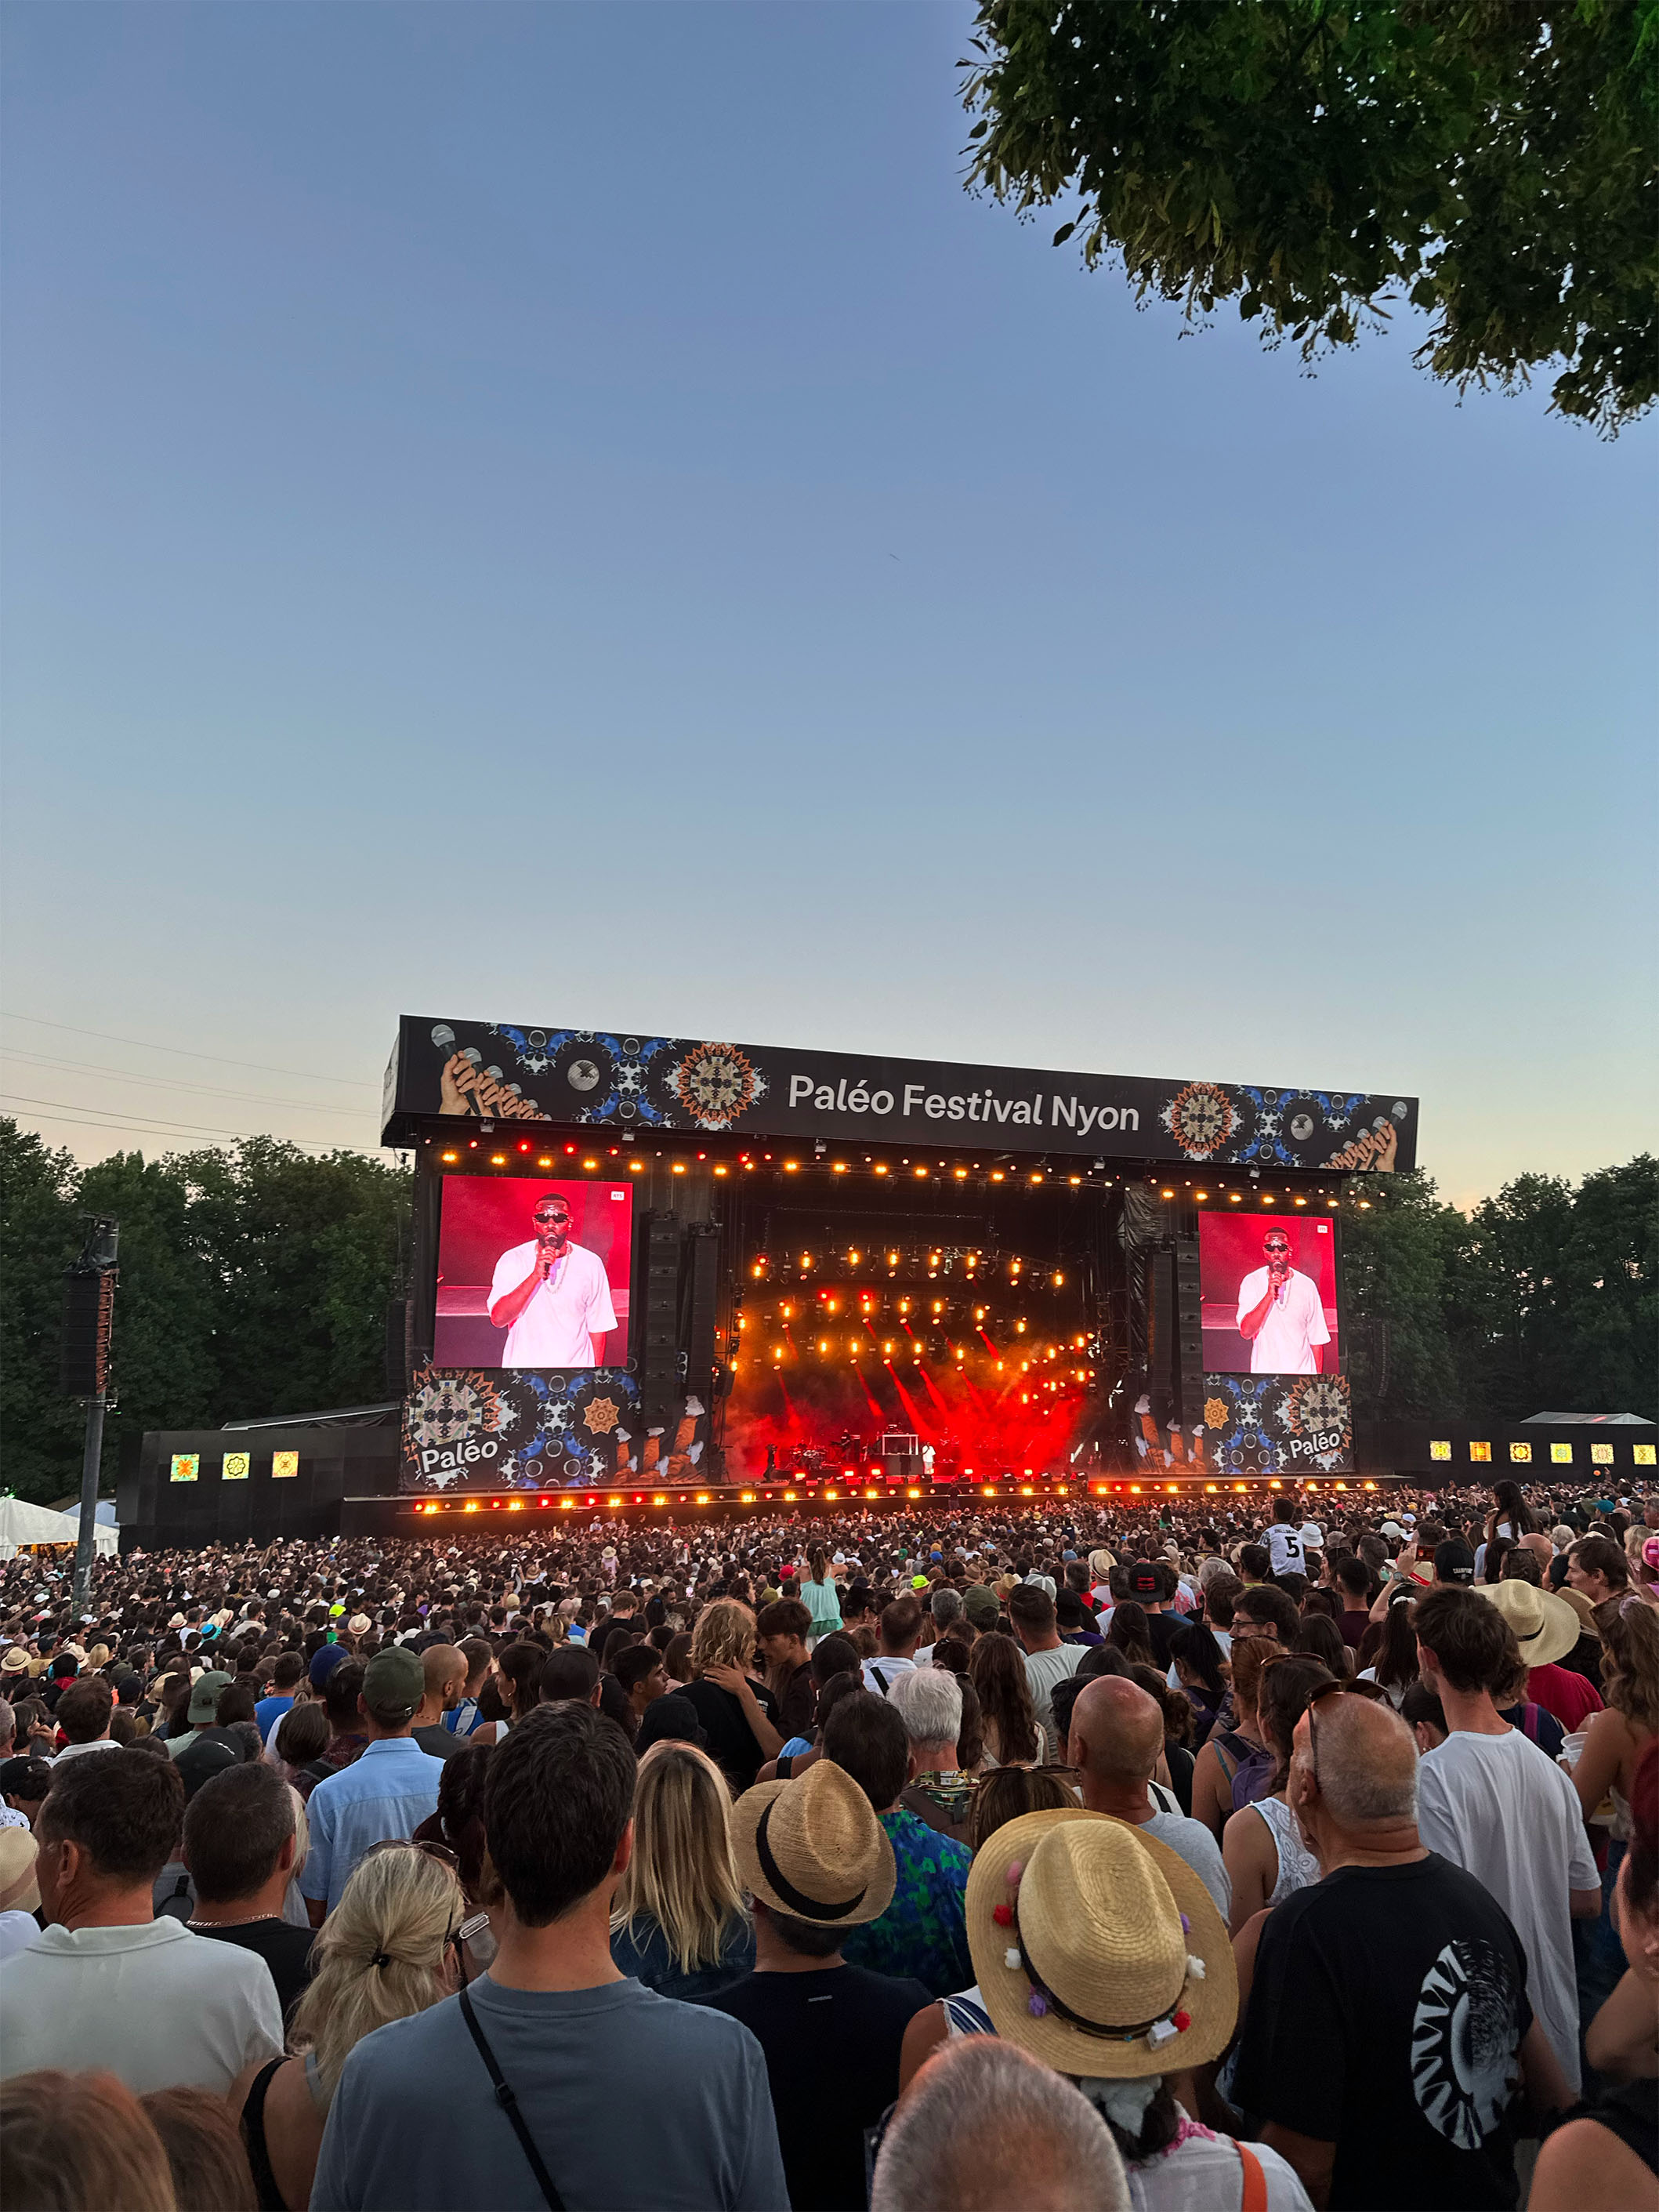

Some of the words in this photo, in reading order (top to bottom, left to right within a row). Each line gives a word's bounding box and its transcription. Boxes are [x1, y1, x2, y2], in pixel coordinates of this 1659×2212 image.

[788, 1075, 895, 1115] Paléo
[903, 1084, 1043, 1125] Festival
[1052, 1095, 1140, 1136] Nyon
[421, 1438, 498, 1473] Paléo
[1289, 1431, 1340, 1459] Paléo
[1284, 1536, 1300, 1558] 5
